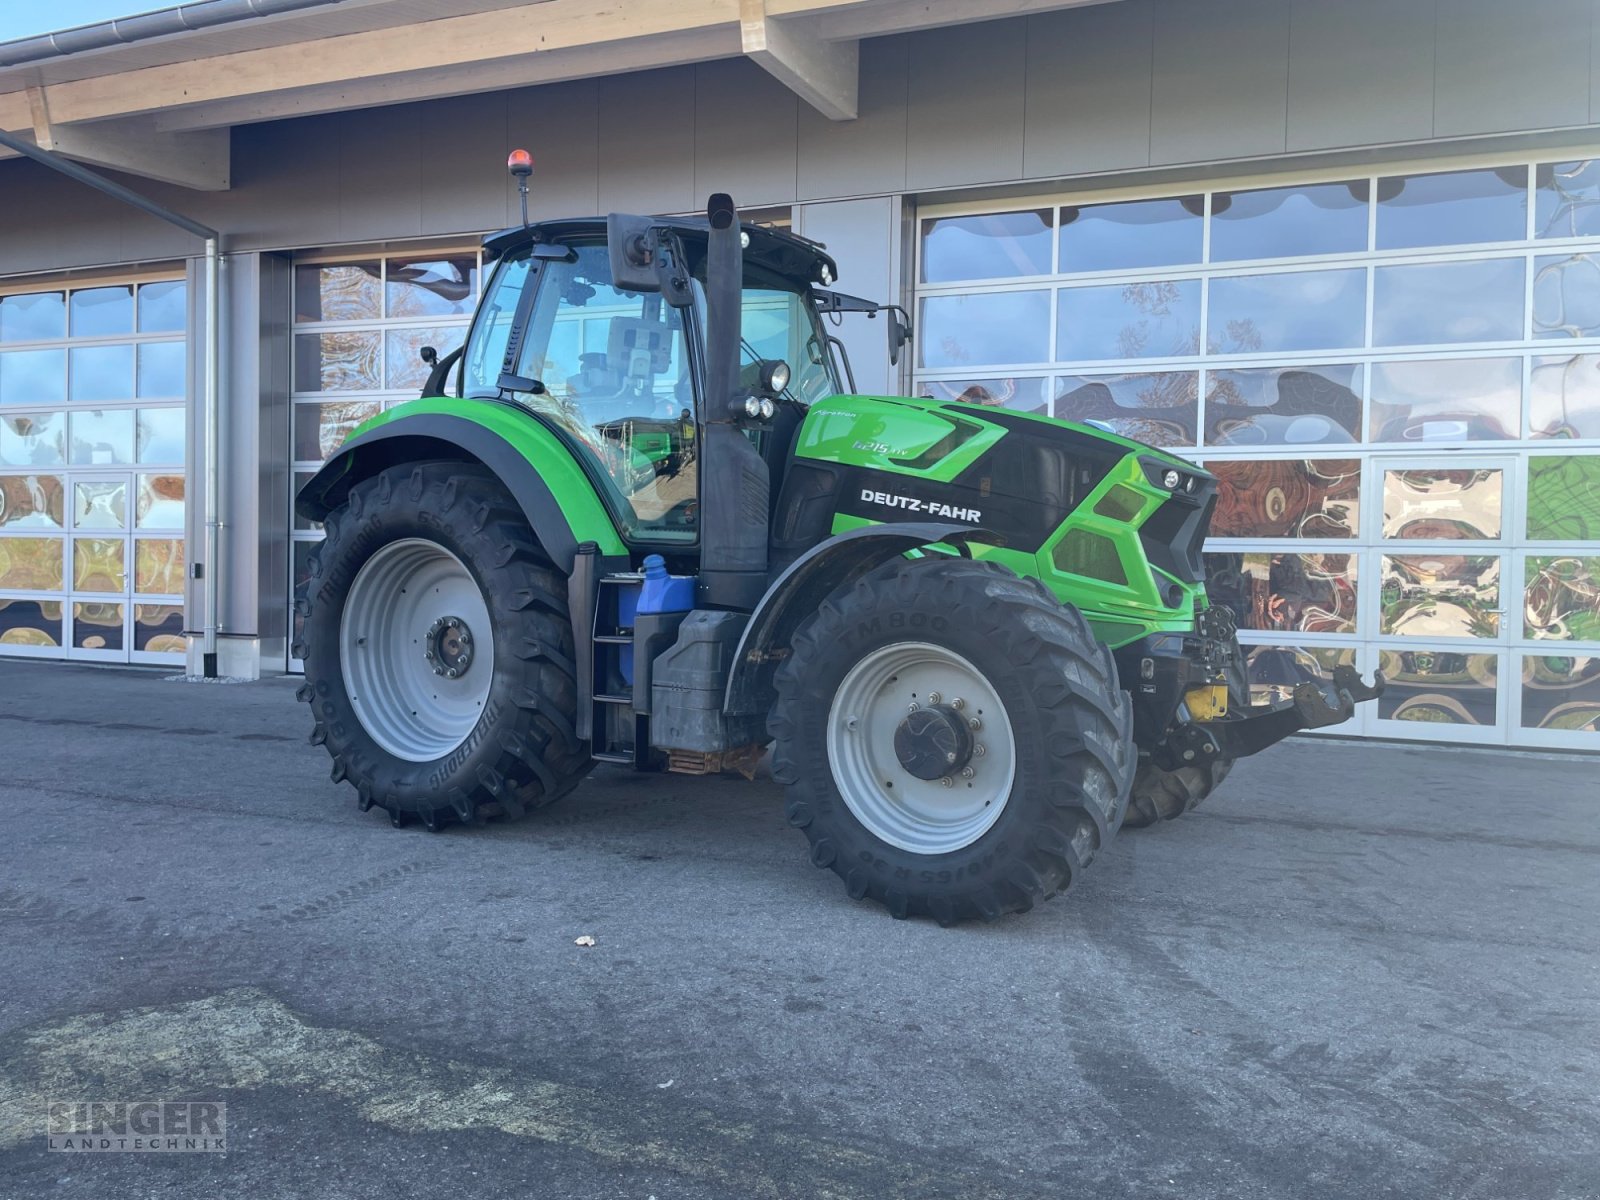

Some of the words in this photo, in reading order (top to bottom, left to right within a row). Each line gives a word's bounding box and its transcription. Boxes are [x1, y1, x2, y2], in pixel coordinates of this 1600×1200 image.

[861, 489, 982, 523] DEUTZ-FAHR
[316, 513, 382, 607] TRELLEBORG
[889, 611, 948, 633] 800
[429, 698, 504, 791] TRELLEBORG
